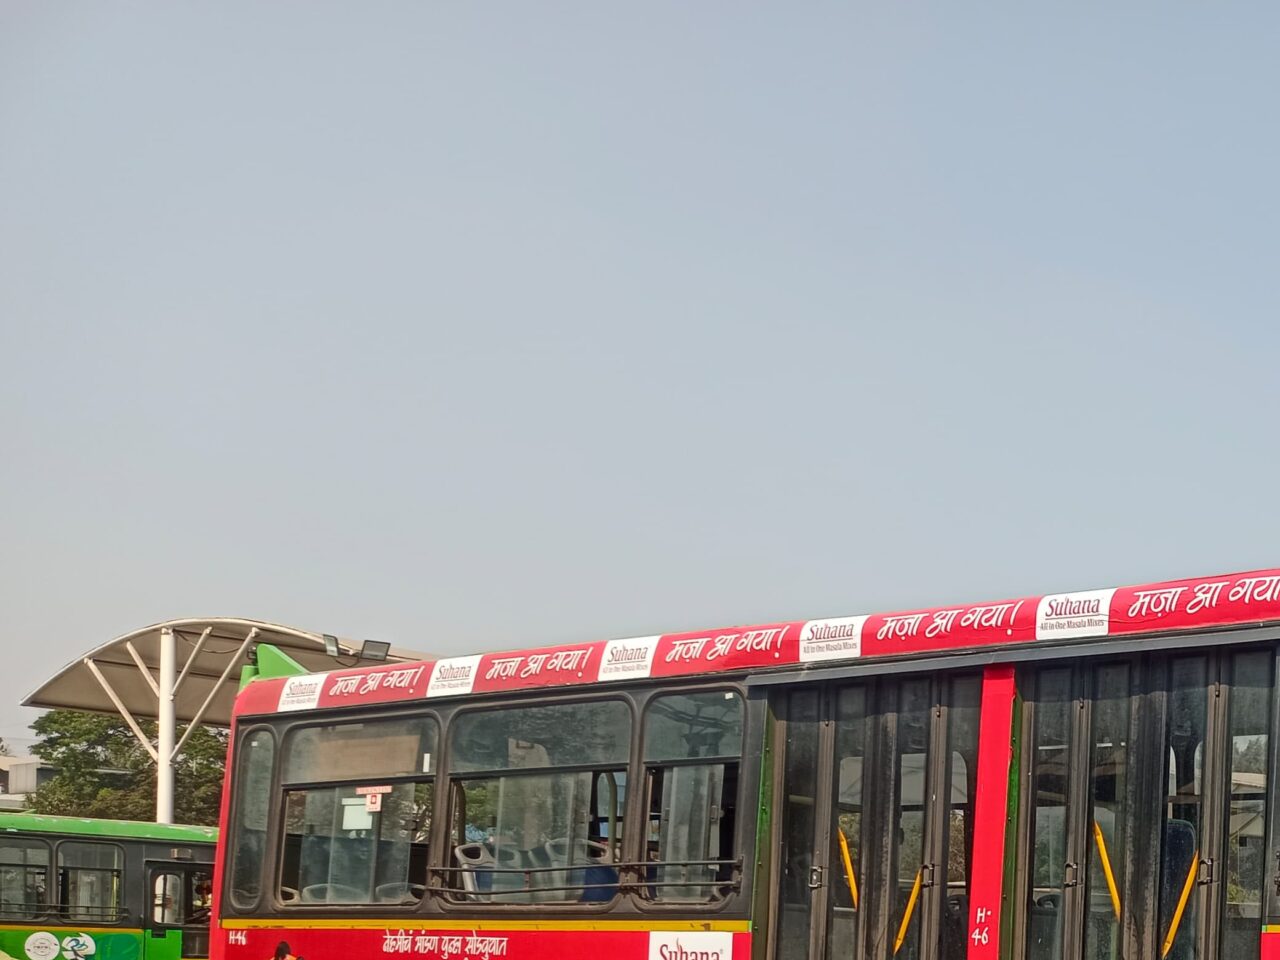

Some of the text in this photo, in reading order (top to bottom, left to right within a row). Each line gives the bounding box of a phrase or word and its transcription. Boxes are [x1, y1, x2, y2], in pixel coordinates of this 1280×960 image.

[1045, 597, 1101, 618] Suhana
[1128, 585, 1189, 618] मज़ा
[1186, 581, 1230, 614] आ
[876, 599, 1024, 641] मज़ा आ गया!
[806, 623, 854, 641] Suhana
[607, 644, 648, 663] Suhana
[666, 624, 790, 663] मज़ा आ गया!
[436, 664, 472, 681] Suhana
[485, 656, 525, 680] मज़ा
[520, 653, 551, 678] आ
[547, 646, 593, 678] गया!
[360, 672, 383, 694] आ
[971, 926, 989, 946] 46
